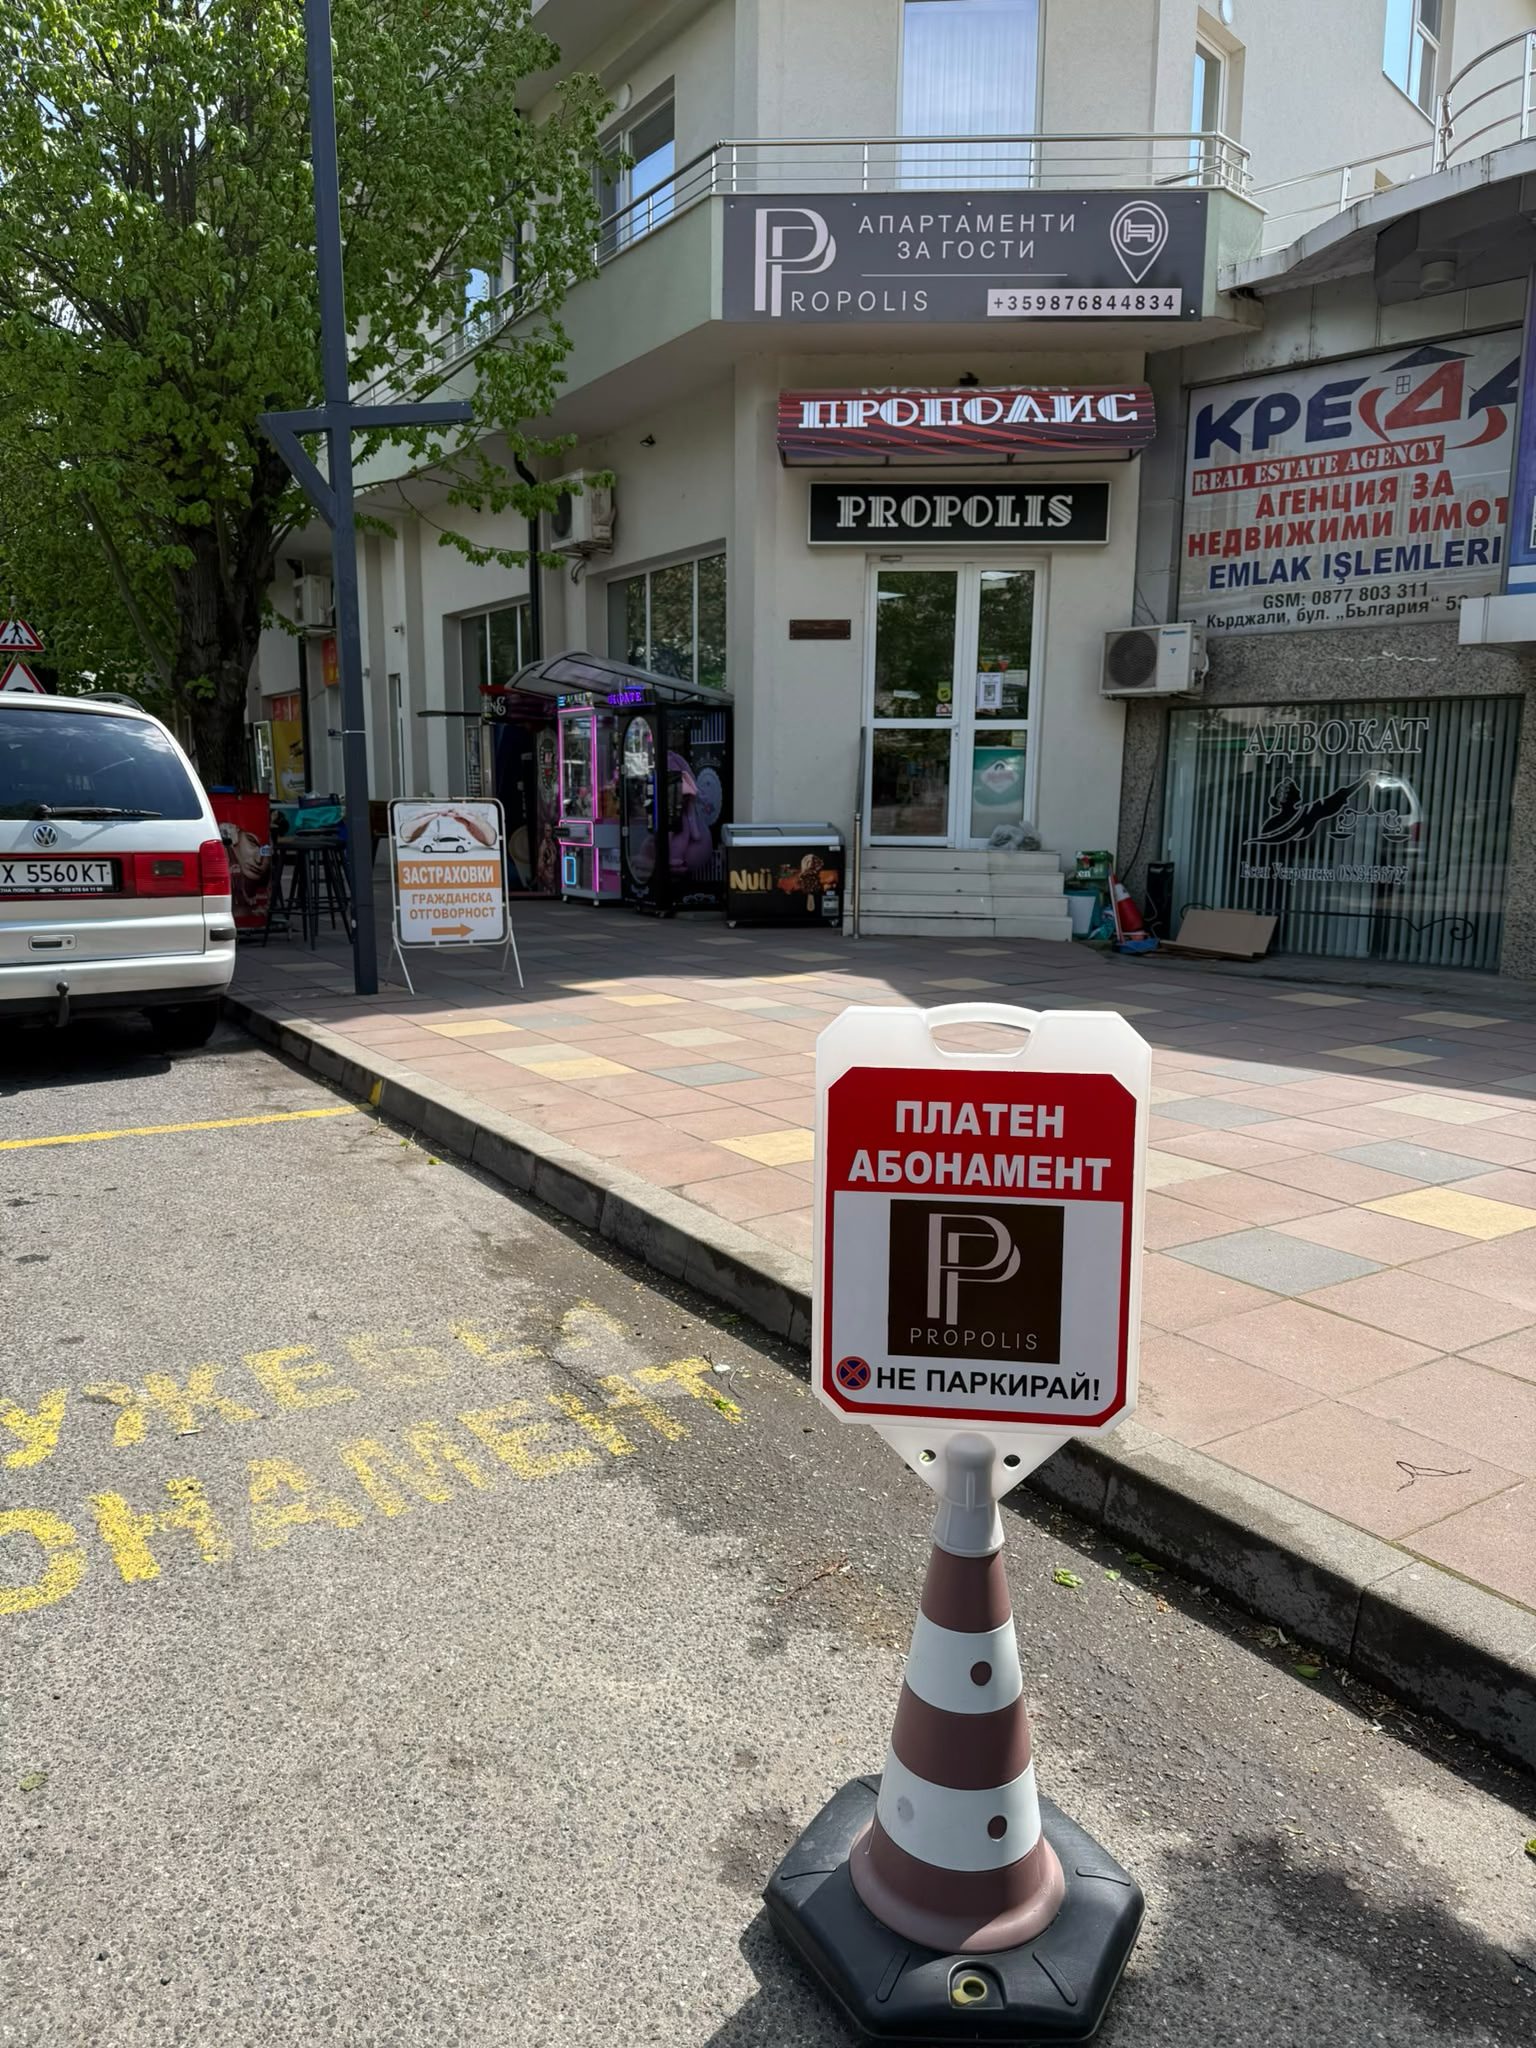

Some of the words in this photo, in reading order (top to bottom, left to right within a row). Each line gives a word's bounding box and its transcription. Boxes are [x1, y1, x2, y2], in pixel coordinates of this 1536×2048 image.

[858, 214, 1076, 234] АПАРТАМЕНТИ
[897, 241, 937, 260] ЗА
[942, 240, 1035, 260] ГОСТИ
[993, 294, 1176, 312] +359876844834
[798, 393, 1138, 429] ПРОПОЛИС
[1193, 468, 1249, 494] REAL
[1255, 454, 1338, 484] ESTATE
[1344, 438, 1443, 472] AGENCY
[1255, 476, 1398, 519] АГЕНЦИЯ
[1413, 469, 1454, 499] ЗА
[836, 495, 1073, 529] PROPOLIS
[1187, 511, 1393, 558] НЕДВИЖИМИ
[1209, 555, 1312, 590] EMLAK
[1263, 593, 1306, 610] GSM:
[1312, 588, 1353, 606] 0877
[1359, 585, 1393, 602] 803
[1397, 581, 1429, 600] 311
[1206, 607, 1291, 632] Кърджали,
[1297, 605, 1330, 626] бул.
[1244, 717, 1430, 765] АДВОКАТ
[2, 864, 16, 884] X
[27, 864, 78, 883] 5560
[82, 864, 108, 882] KT
[403, 865, 494, 884] ЗАСТРАХОВКИ
[409, 906, 496, 920] ОТГОВОРНОСТ
[411, 891, 493, 906] ГРАЖДАНСКА
[896, 1100, 1064, 1139] ПЛАТЕН
[848, 1149, 1111, 1191] АБОНАМЕНТ
[910, 1327, 1038, 1351] PROPOLIS
[877, 1367, 917, 1391] НЕ
[927, 1369, 1100, 1401] ПАРКИРАЙ!
